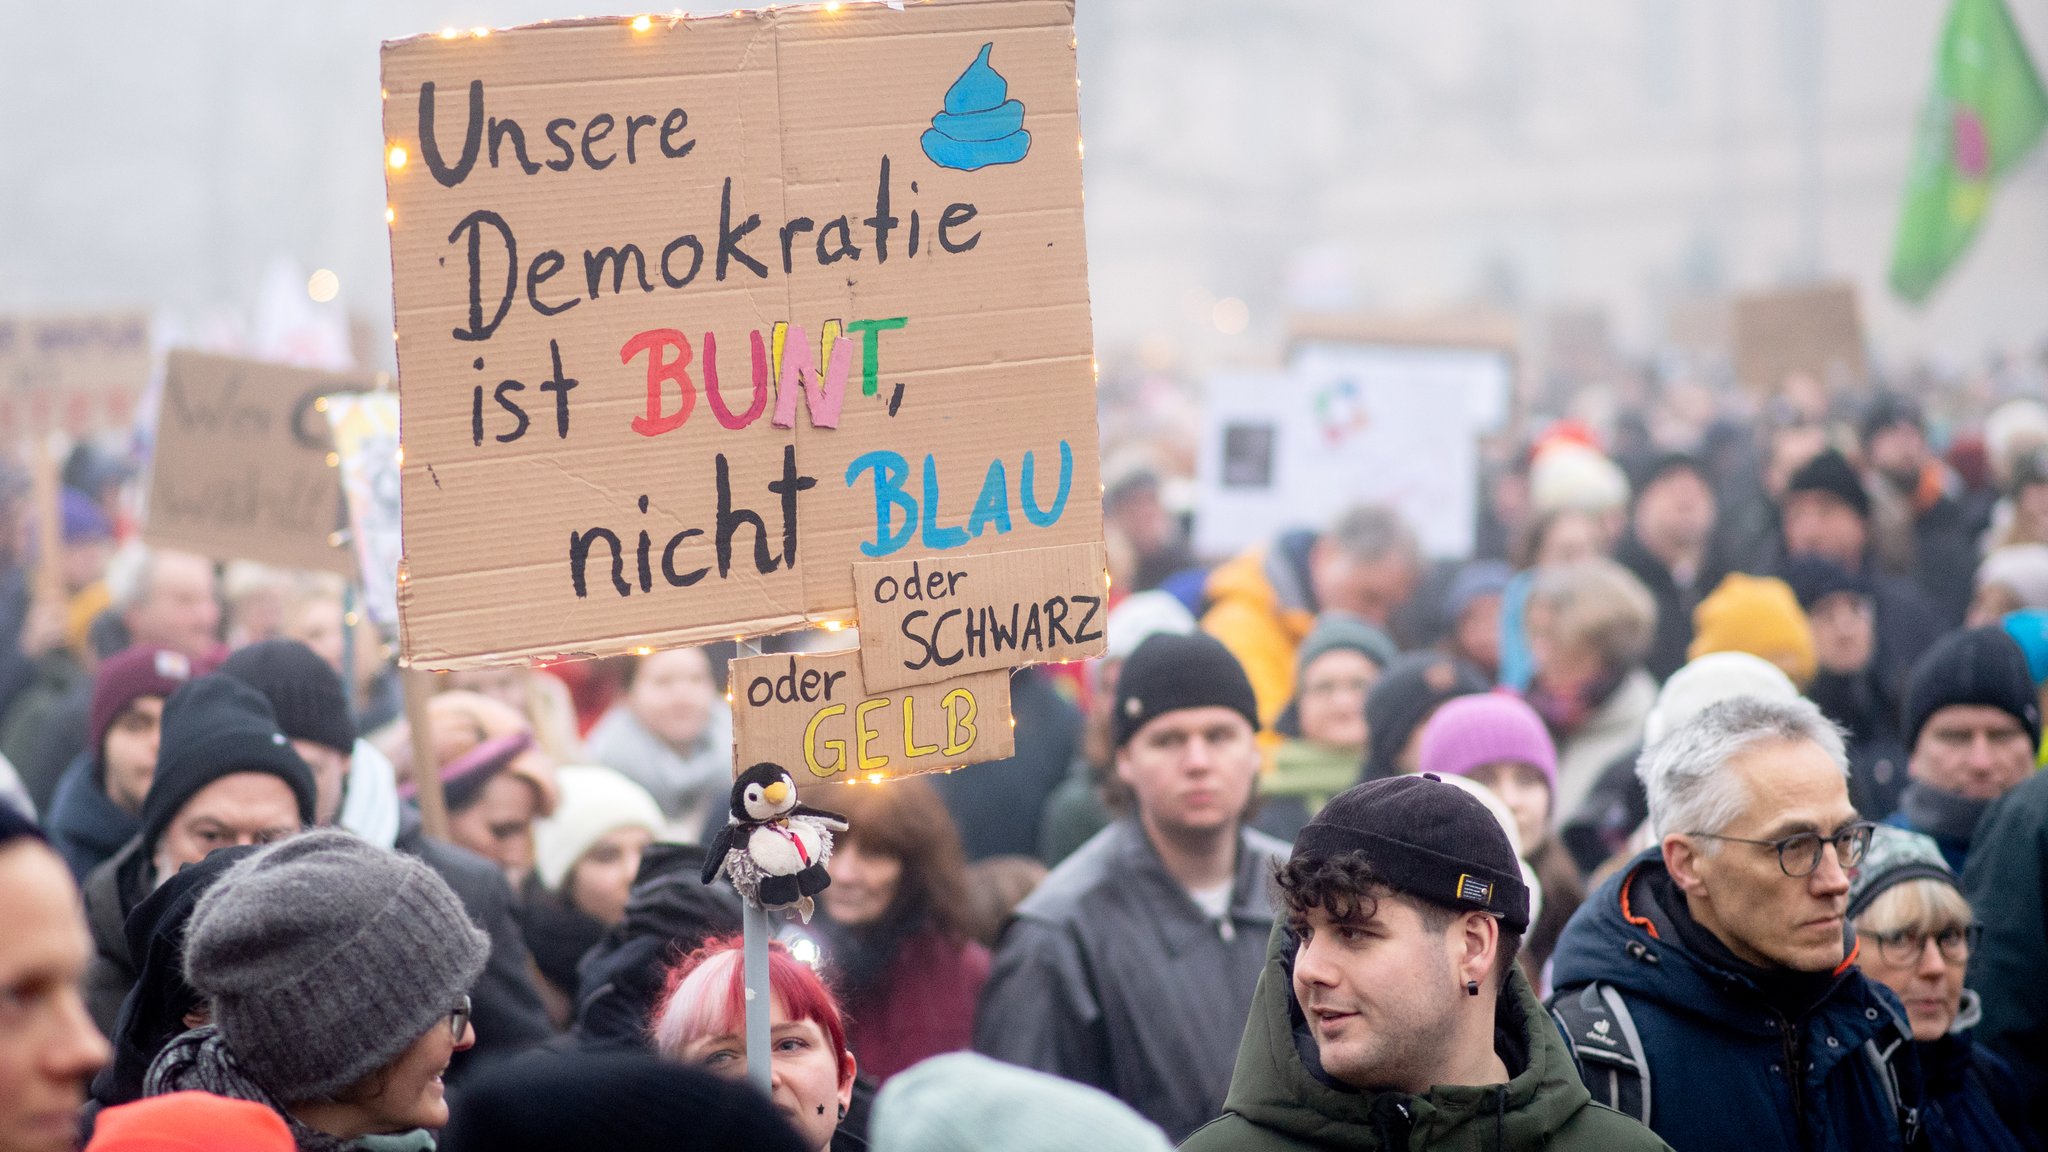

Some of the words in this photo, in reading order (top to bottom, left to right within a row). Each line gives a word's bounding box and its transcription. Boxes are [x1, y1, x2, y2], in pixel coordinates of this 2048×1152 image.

[419, 80, 696, 187] Unsere
[448, 154, 982, 341] Demokratie
[472, 339, 579, 446] ist
[620, 317, 908, 437] BUNT,
[570, 444, 818, 599] nicht
[845, 440, 1073, 557] BLAU
[875, 561, 968, 603] oder
[748, 656, 846, 706] oder
[902, 595, 1102, 670] SCHWARZ
[803, 688, 978, 777] GELB
